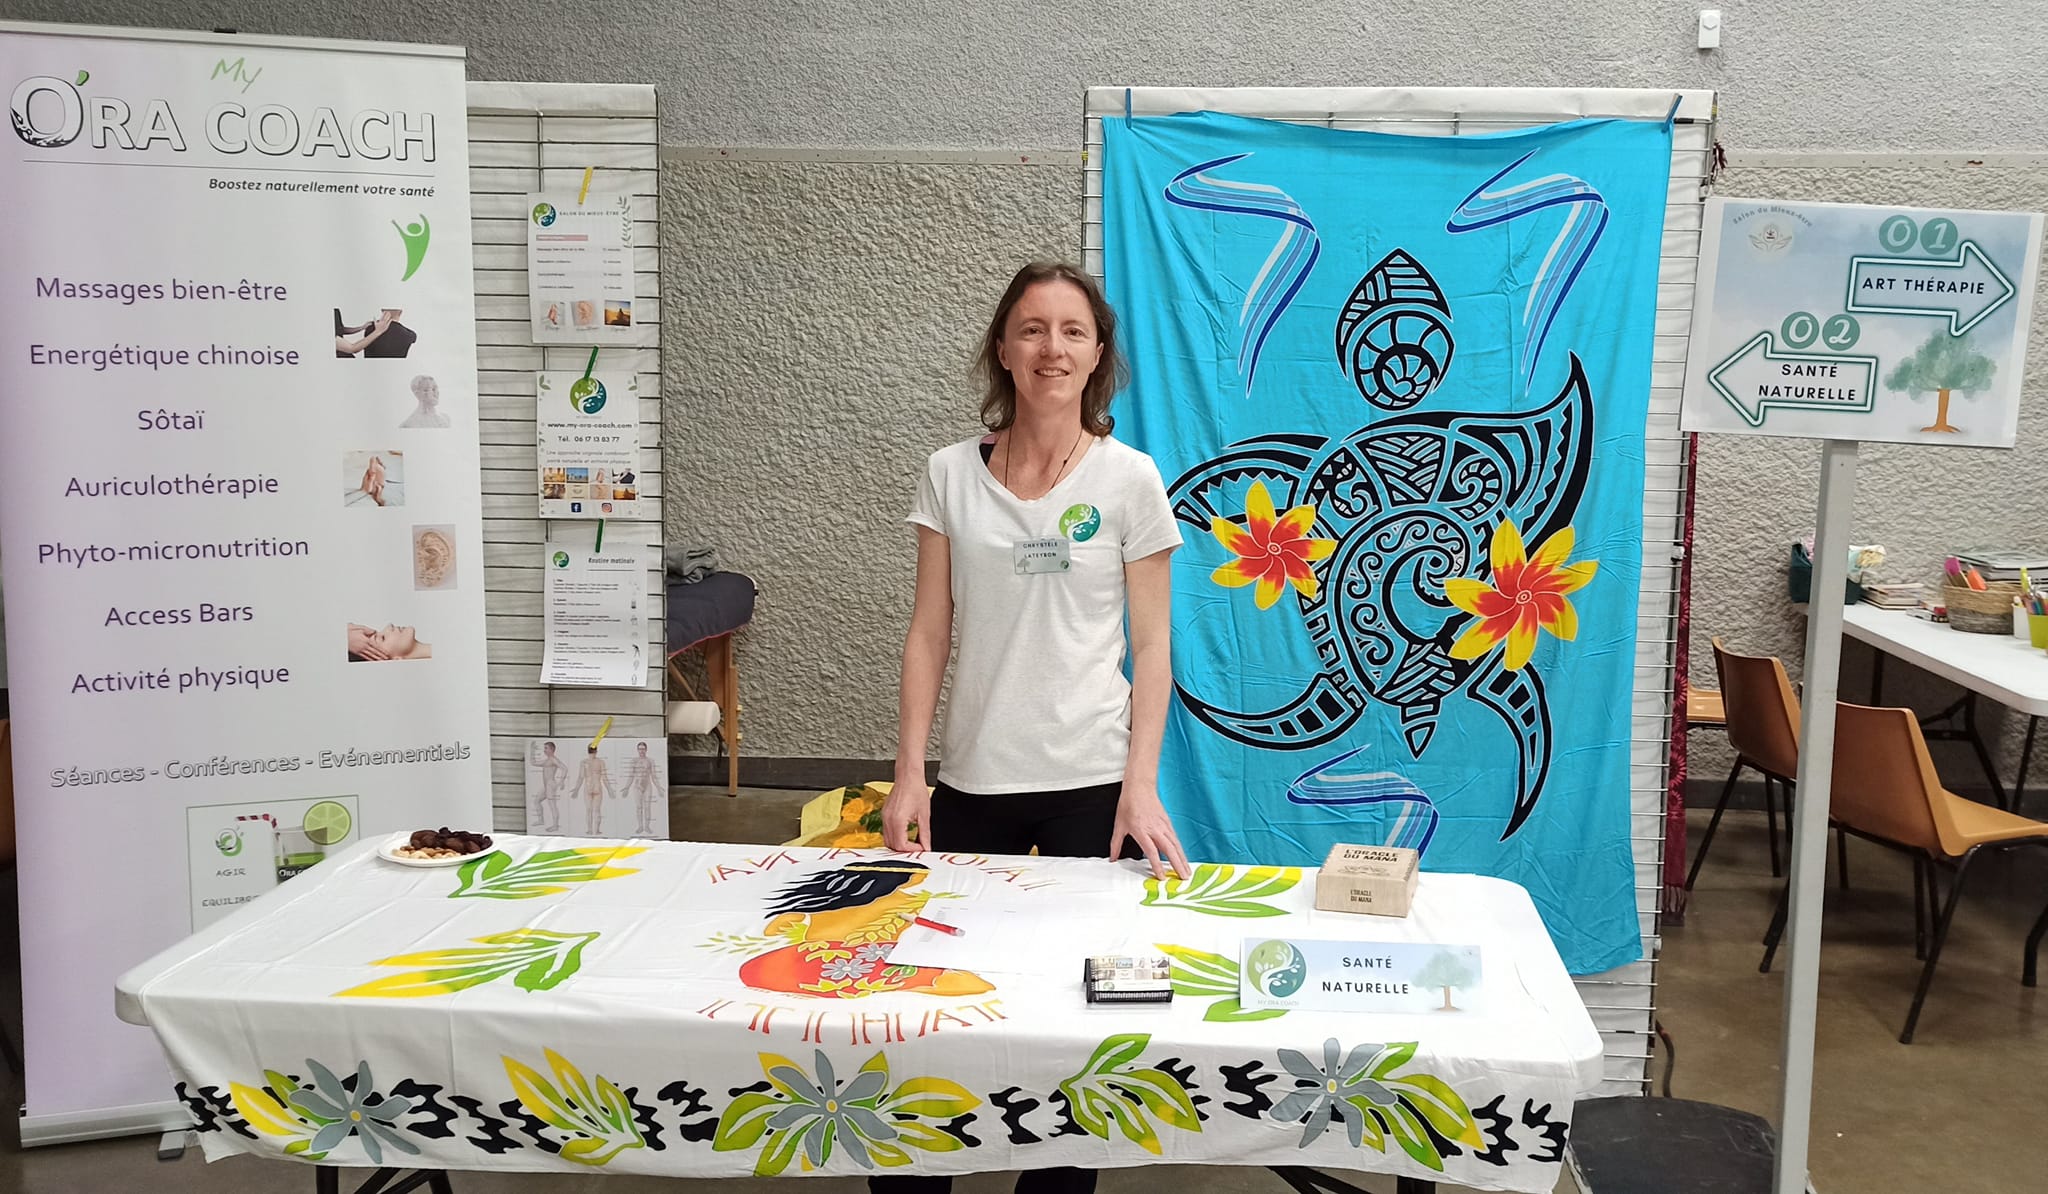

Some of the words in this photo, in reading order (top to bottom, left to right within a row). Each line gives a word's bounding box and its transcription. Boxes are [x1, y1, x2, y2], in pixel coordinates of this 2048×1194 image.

[211, 57, 262, 93] My
[204, 101, 436, 162] COACH
[209, 178, 261, 192] Boostez
[265, 180, 359, 194] naturellement
[363, 184, 396, 196] votre
[399, 185, 435, 197] santé
[36, 277, 164, 304] Massages
[172, 278, 288, 301] bien-être
[1862, 277, 1897, 291] ART
[1904, 276, 1985, 295] THÉRAPIE
[30, 343, 190, 371] Energétique
[197, 344, 300, 366] chinoise
[1781, 362, 1839, 378] SANTÉ
[1758, 384, 1857, 401] NATURELLE
[138, 408, 205, 431] Sôtaï
[547, 421, 632, 429] www.my-ora-coach.com
[65, 474, 279, 499] Auriculothérapie
[38, 537, 310, 568] Phyto-micronutrition
[104, 604, 192, 627] Access
[200, 603, 254, 623] Bars
[71, 667, 171, 694] Activité
[178, 665, 290, 693] physique
[50, 763, 145, 788] Séances
[164, 754, 300, 779] Conférences
[318, 741, 471, 769] Evénementiels
[1345, 849, 1399, 858] L'ORACLE
[216, 868, 246, 877] AGIR
[202, 895, 261, 907] EQUILIBR
[1342, 956, 1392, 969] SANTÉ
[1322, 981, 1409, 994] NATURELLE
